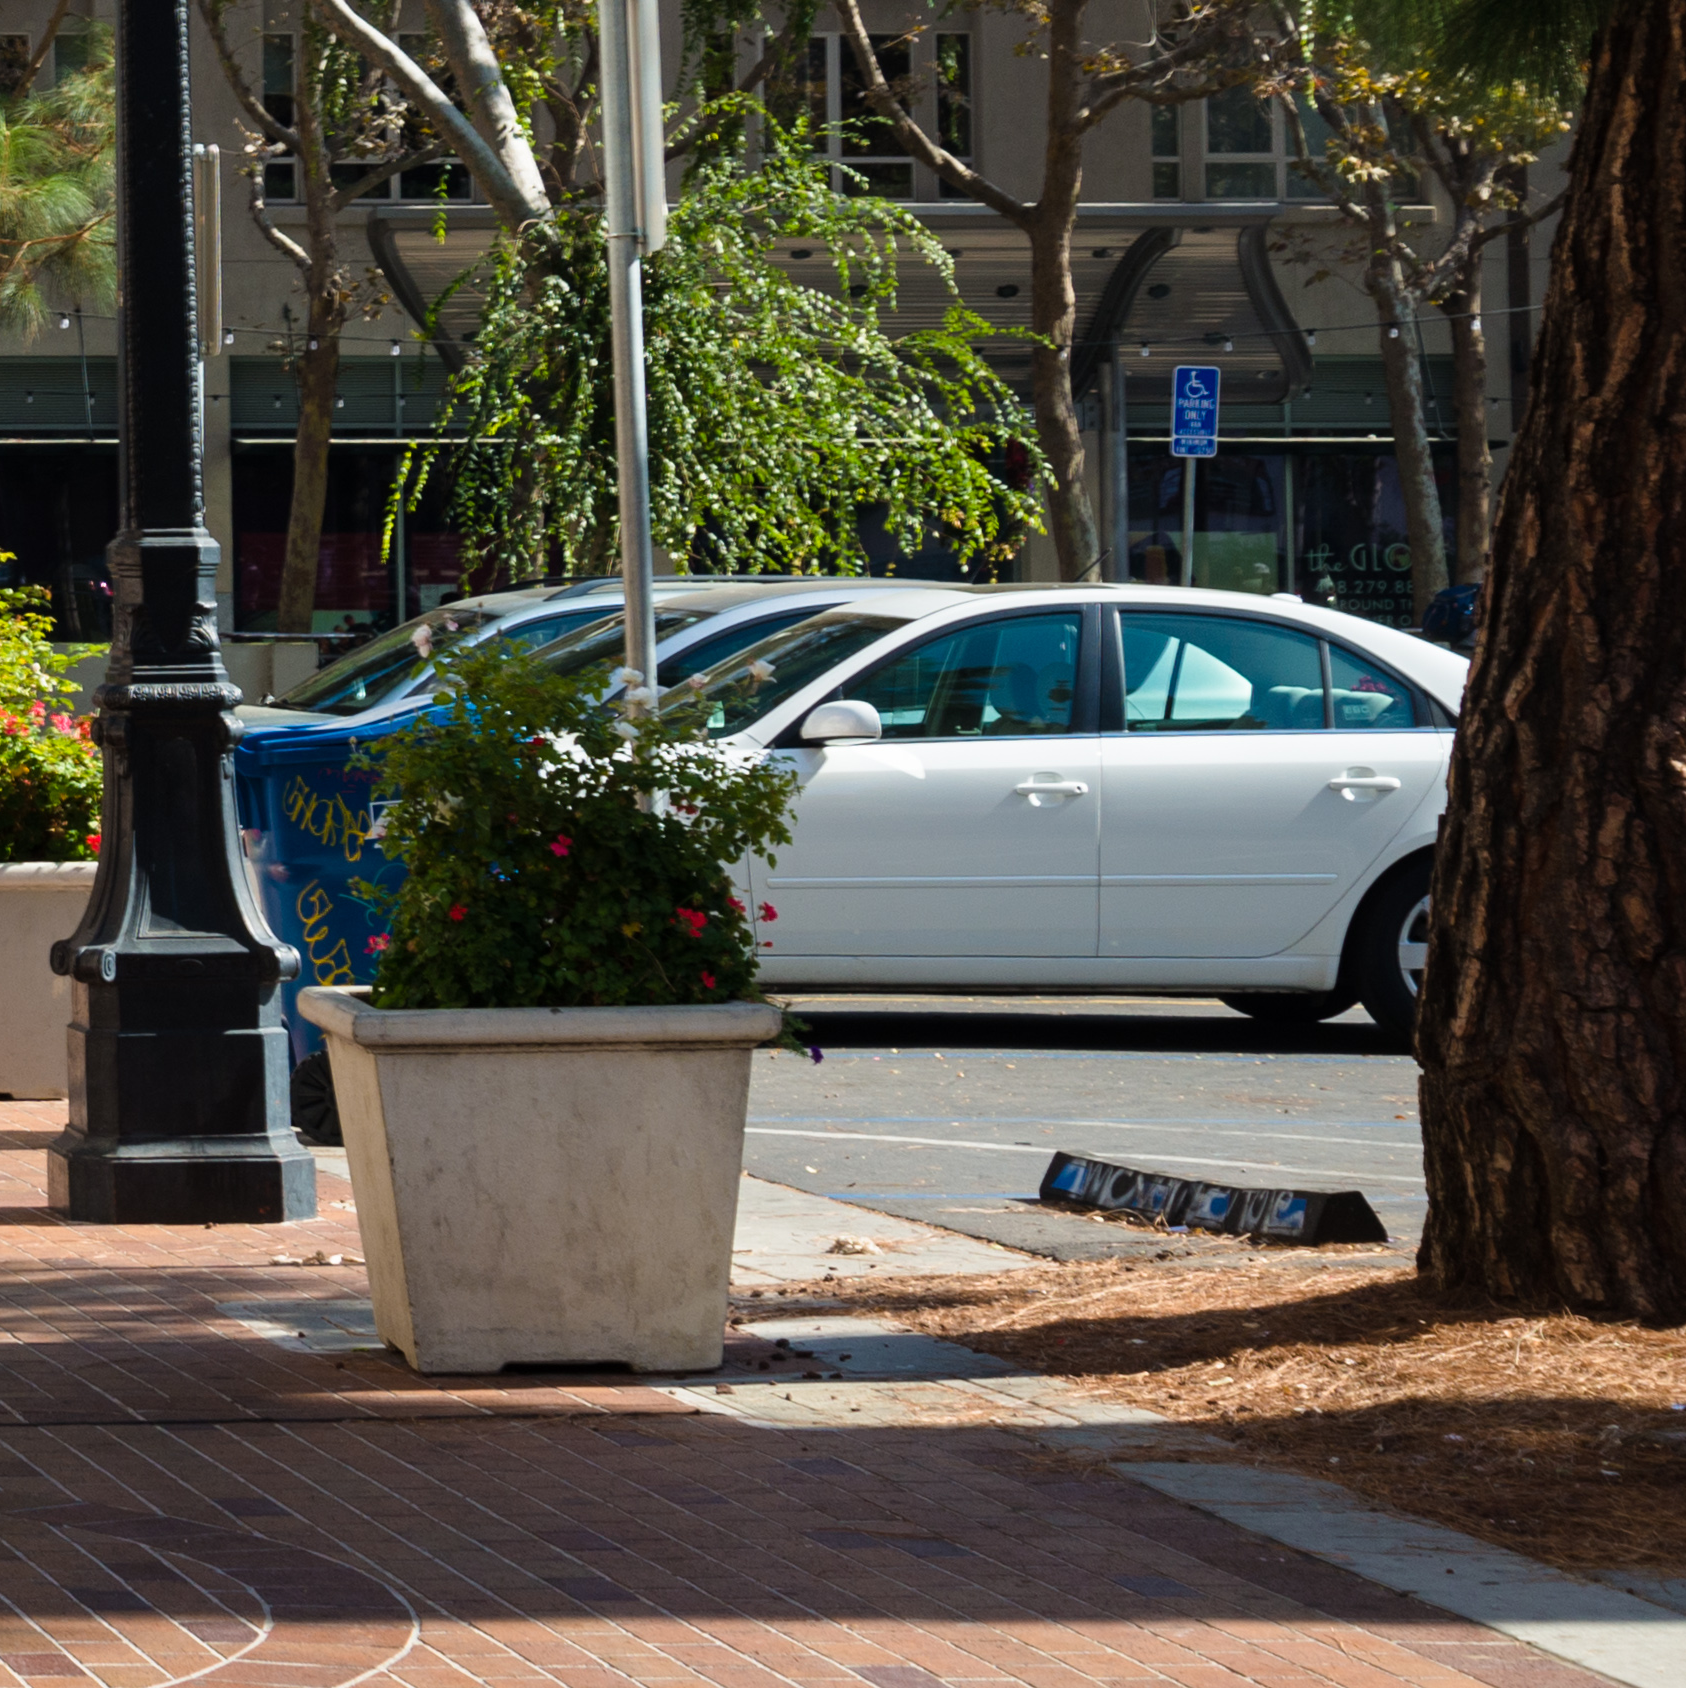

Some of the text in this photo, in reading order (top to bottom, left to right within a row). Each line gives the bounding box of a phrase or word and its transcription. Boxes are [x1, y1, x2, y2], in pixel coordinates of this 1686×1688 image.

[1178, 398, 1215, 410] PARKING
[1184, 410, 1207, 421] ONLY
[1304, 543, 1348, 572] the
